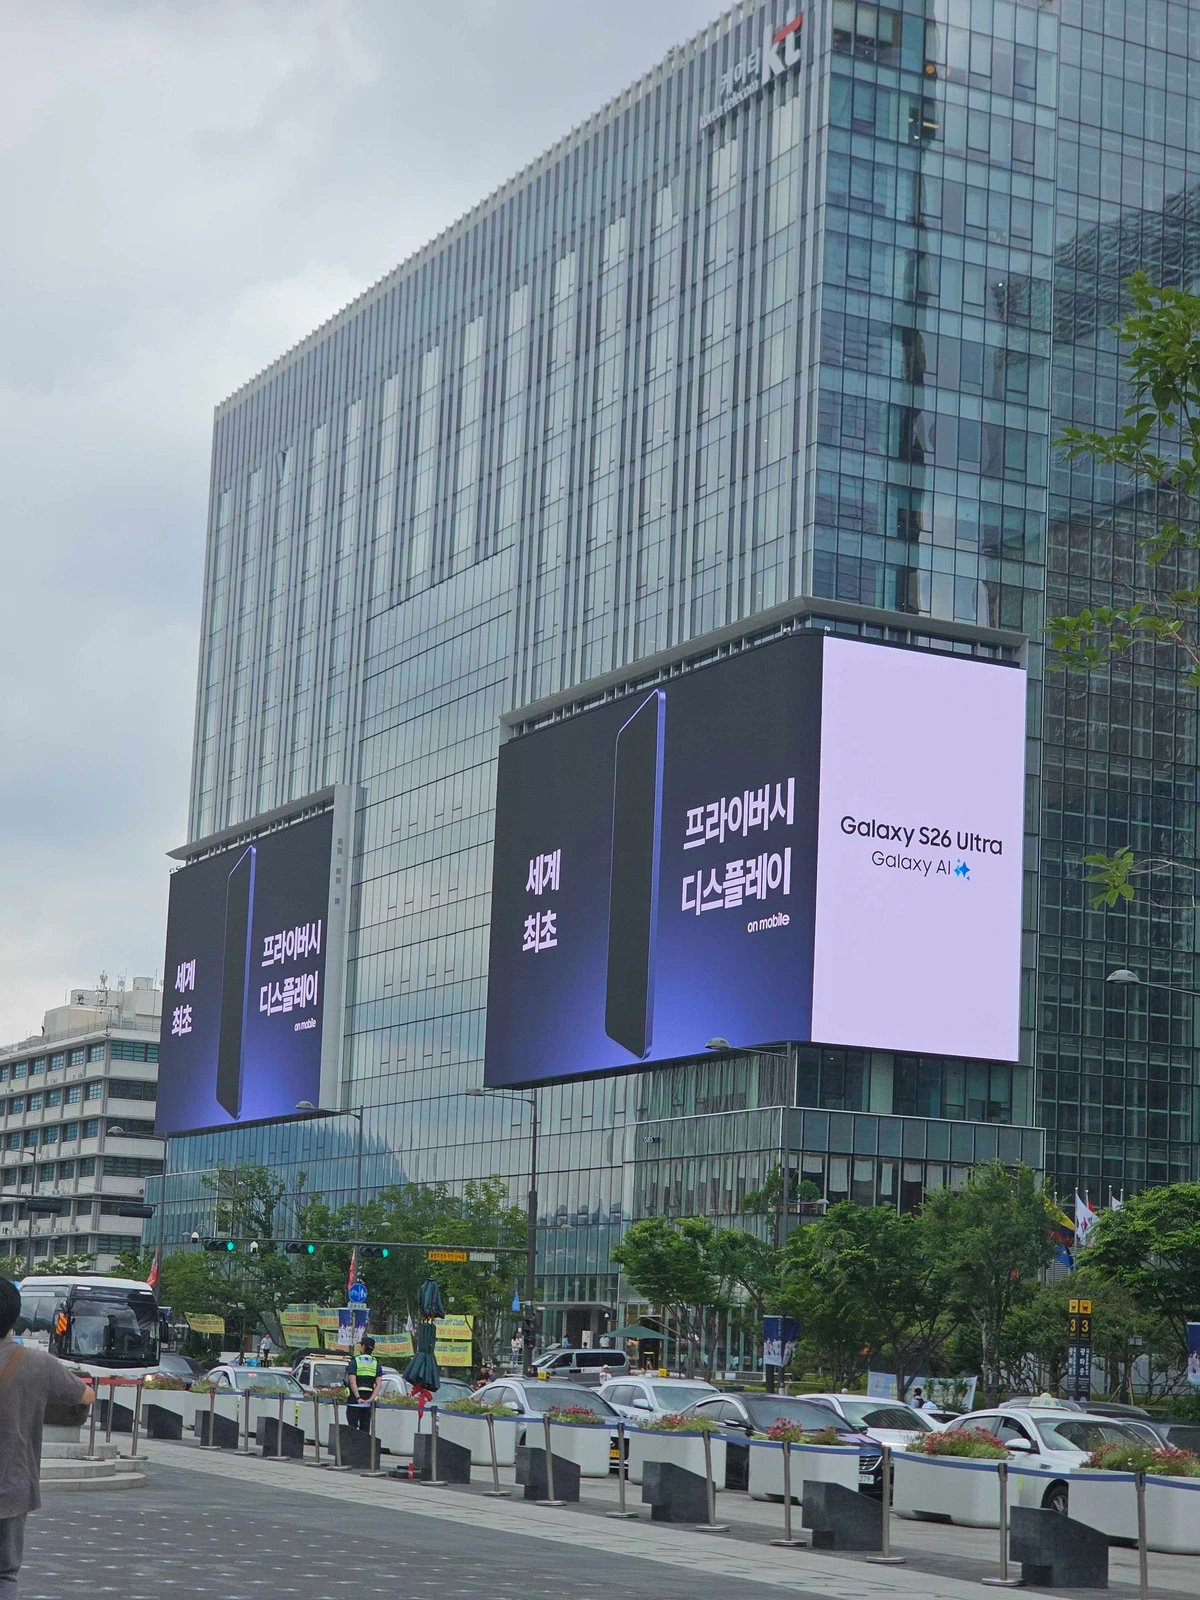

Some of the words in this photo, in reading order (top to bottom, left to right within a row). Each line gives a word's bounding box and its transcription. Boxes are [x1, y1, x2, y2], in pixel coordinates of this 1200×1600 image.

[724, 80, 760, 114] telecom
[683, 777, 795, 850] 프라이버시
[840, 815, 915, 848] Galaxy
[919, 826, 952, 848] S26
[957, 831, 1003, 856] Ultra
[525, 849, 561, 895] 세계
[871, 850, 933, 878] Galaxy
[936, 859, 951, 876] AI
[681, 847, 791, 916] 디스플레이
[522, 909, 558, 954] 최초
[747, 919, 758, 933] on
[759, 912, 790, 931] mobile
[261, 919, 322, 967] 프라이버시
[175, 959, 196, 993] 세계
[259, 970, 319, 1016] 디스플레이
[171, 1004, 193, 1037] 최초
[294, 1022, 300, 1032] on
[301, 1018, 316, 1030] mobile
[1070, 1319, 1076, 1331] 3
[1081, 1320, 1088, 1332] 3
